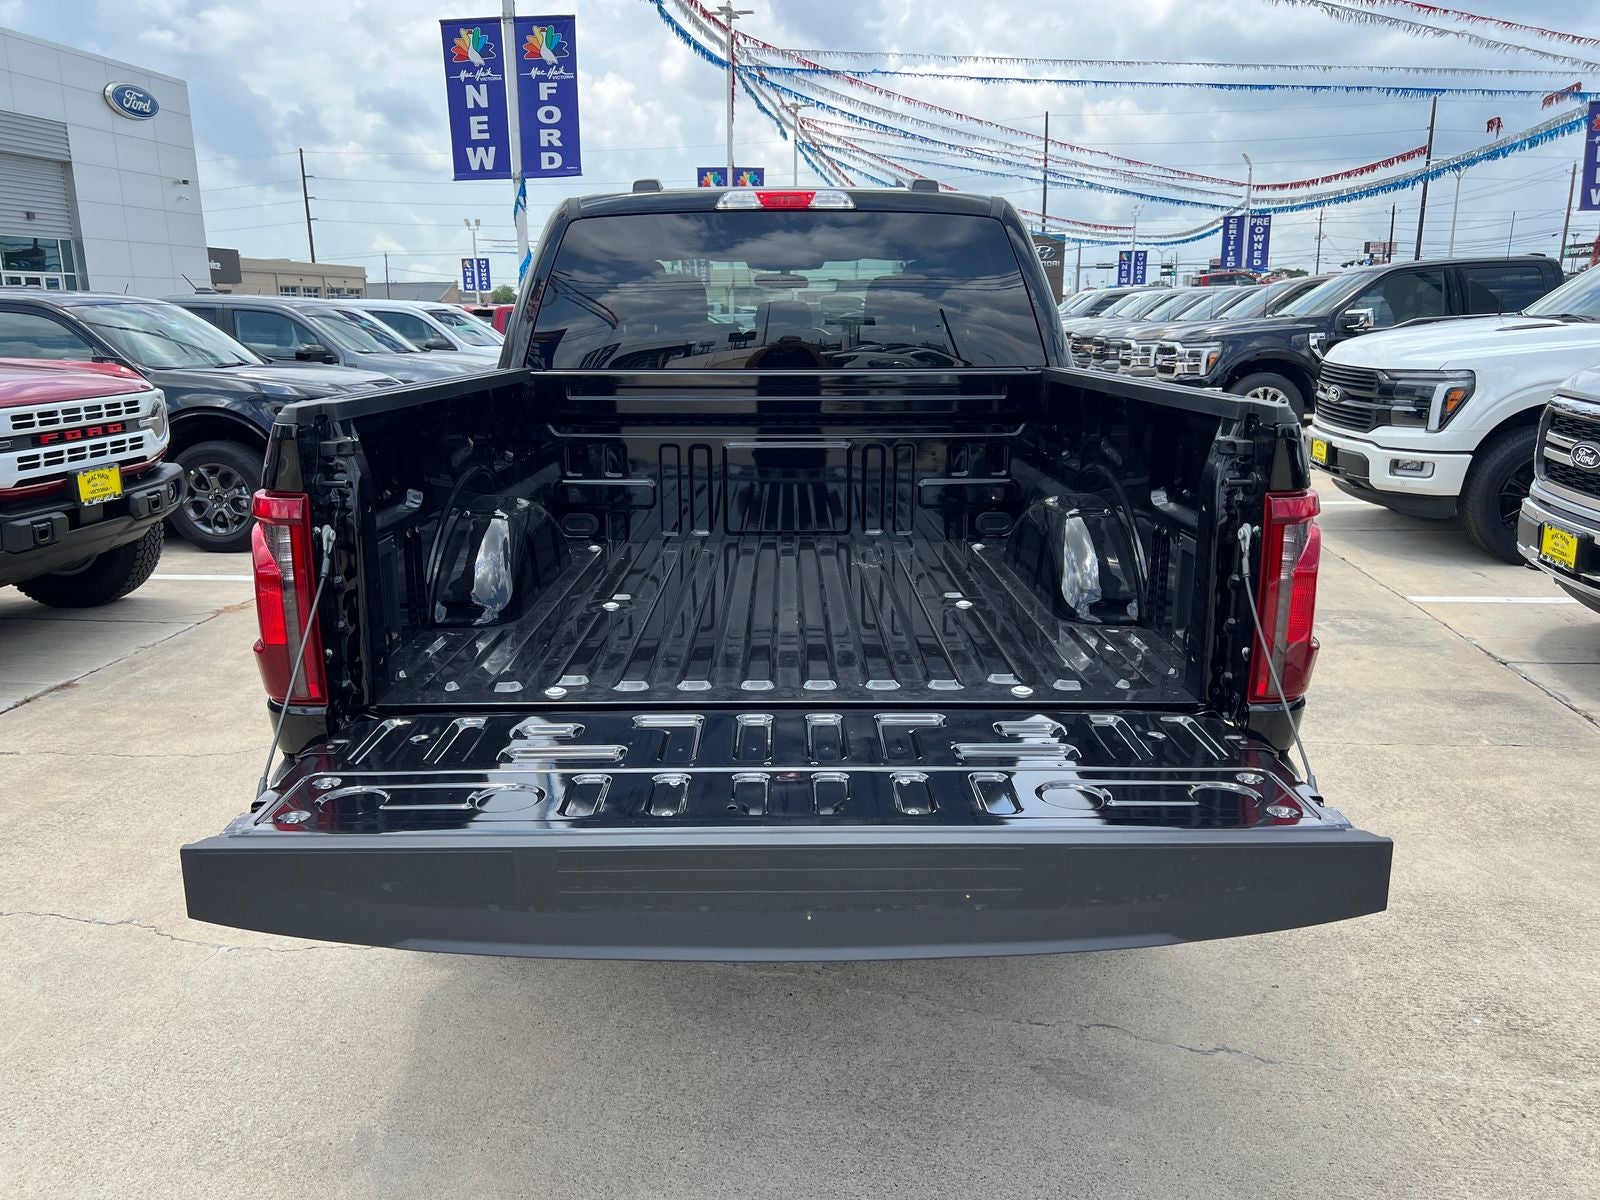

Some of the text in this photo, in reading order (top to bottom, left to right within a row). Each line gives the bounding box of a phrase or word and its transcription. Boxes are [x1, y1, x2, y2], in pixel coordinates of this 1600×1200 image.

[123, 89, 151, 112] Ford
[465, 84, 496, 171] NEW
[537, 82, 563, 170] FORD
[1250, 217, 1270, 226] PRE
[1226, 218, 1238, 267] CERTIFIED
[1252, 226, 1265, 266] OWNED
[1119, 263, 1129, 284] NEW
[1136, 252, 1145, 283] HYUNDAI
[465, 271, 474, 290] NEW
[41, 422, 123, 445] FORD
[1575, 447, 1597, 465] Ford
